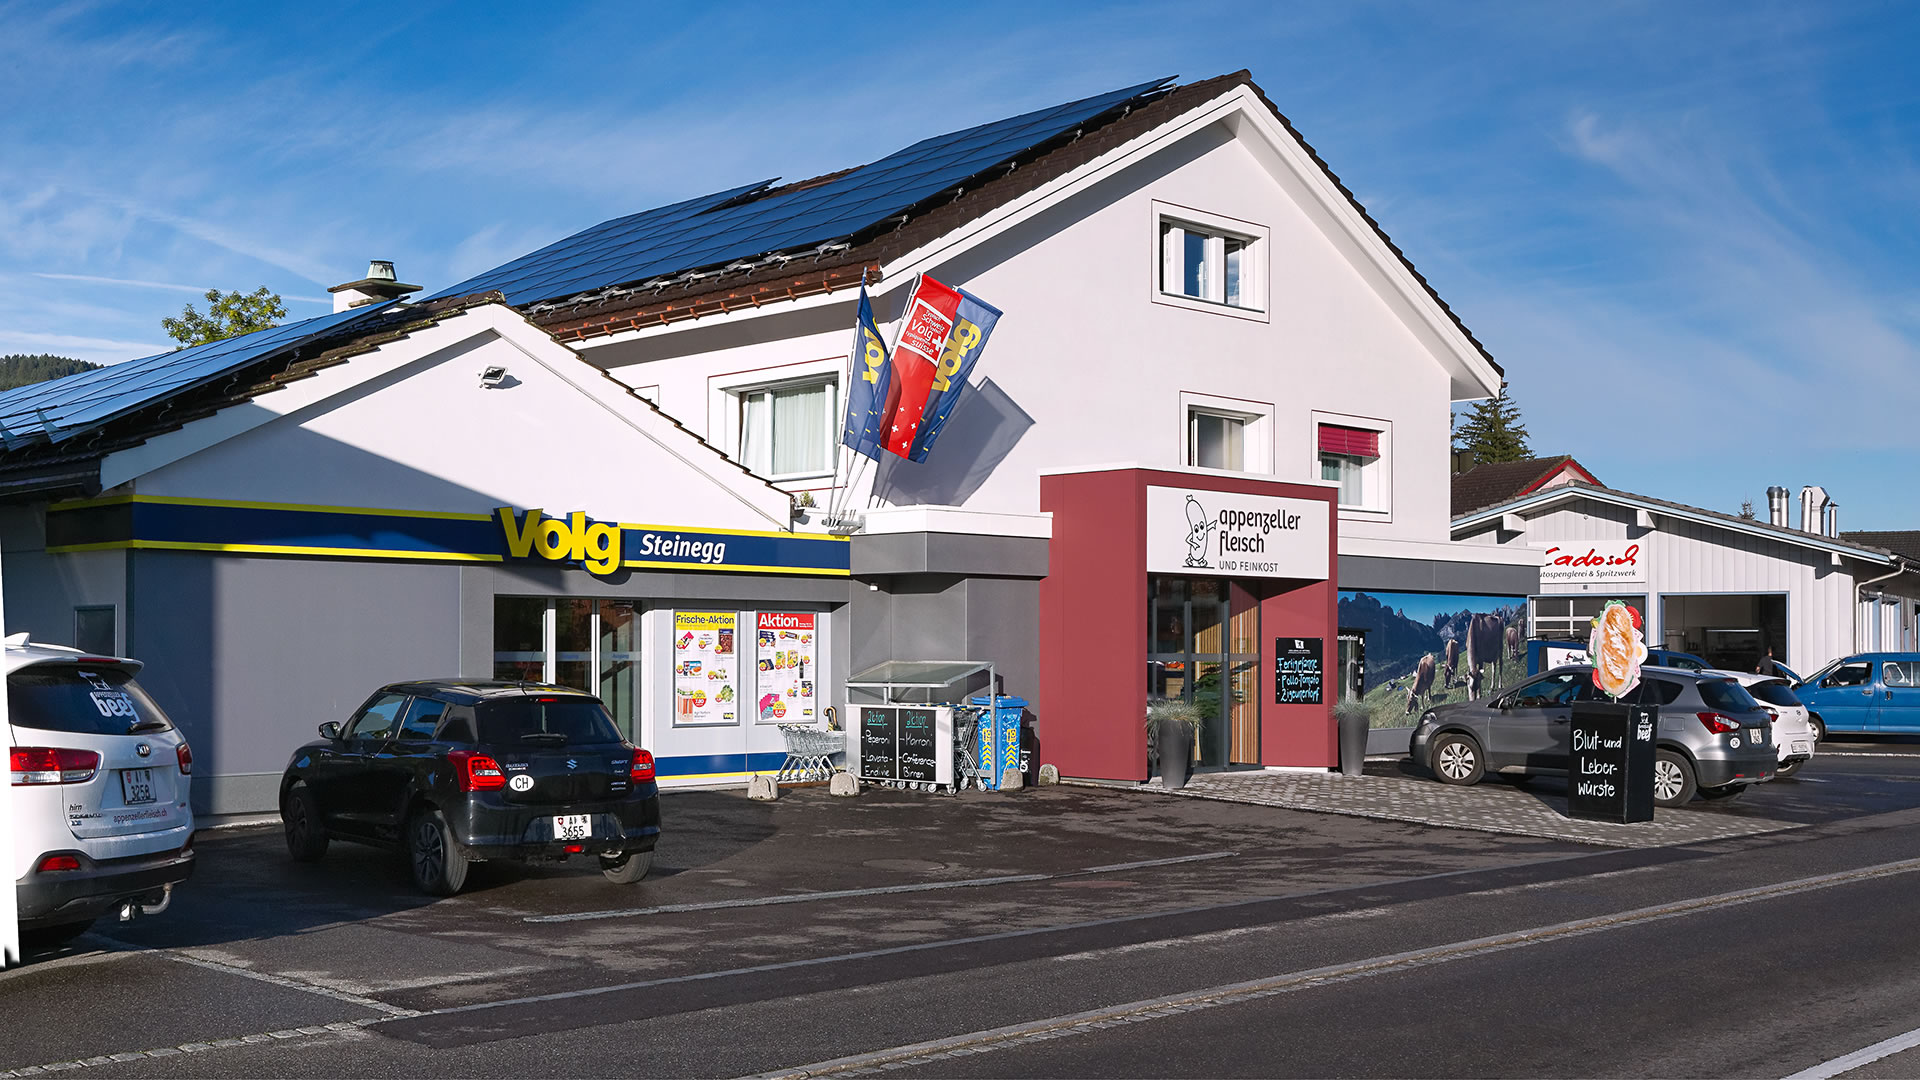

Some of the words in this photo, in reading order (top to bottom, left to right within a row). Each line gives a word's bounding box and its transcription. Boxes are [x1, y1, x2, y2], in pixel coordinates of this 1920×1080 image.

[911, 319, 934, 342] Volg
[921, 313, 945, 332] Schweiz
[910, 340, 934, 355] suisse
[931, 318, 982, 392] Volg
[1219, 509, 1301, 534] appenzeller
[497, 507, 621, 575] Volg
[639, 533, 726, 564] Steinegg
[1219, 530, 1265, 556] fleisch
[1219, 561, 1238, 571] UND
[1240, 562, 1279, 572] FEINKOST
[1596, 569, 1637, 579] Spritzwerk
[676, 614, 735, 625] Frische-Aktion
[759, 613, 799, 628] Aktion
[90, 691, 141, 723] beef
[1581, 756, 1618, 775] Leber-
[515, 777, 529, 789] CH
[1577, 779, 1616, 797] würste
[569, 816, 577, 825] AI
[562, 826, 585, 837] 3655
